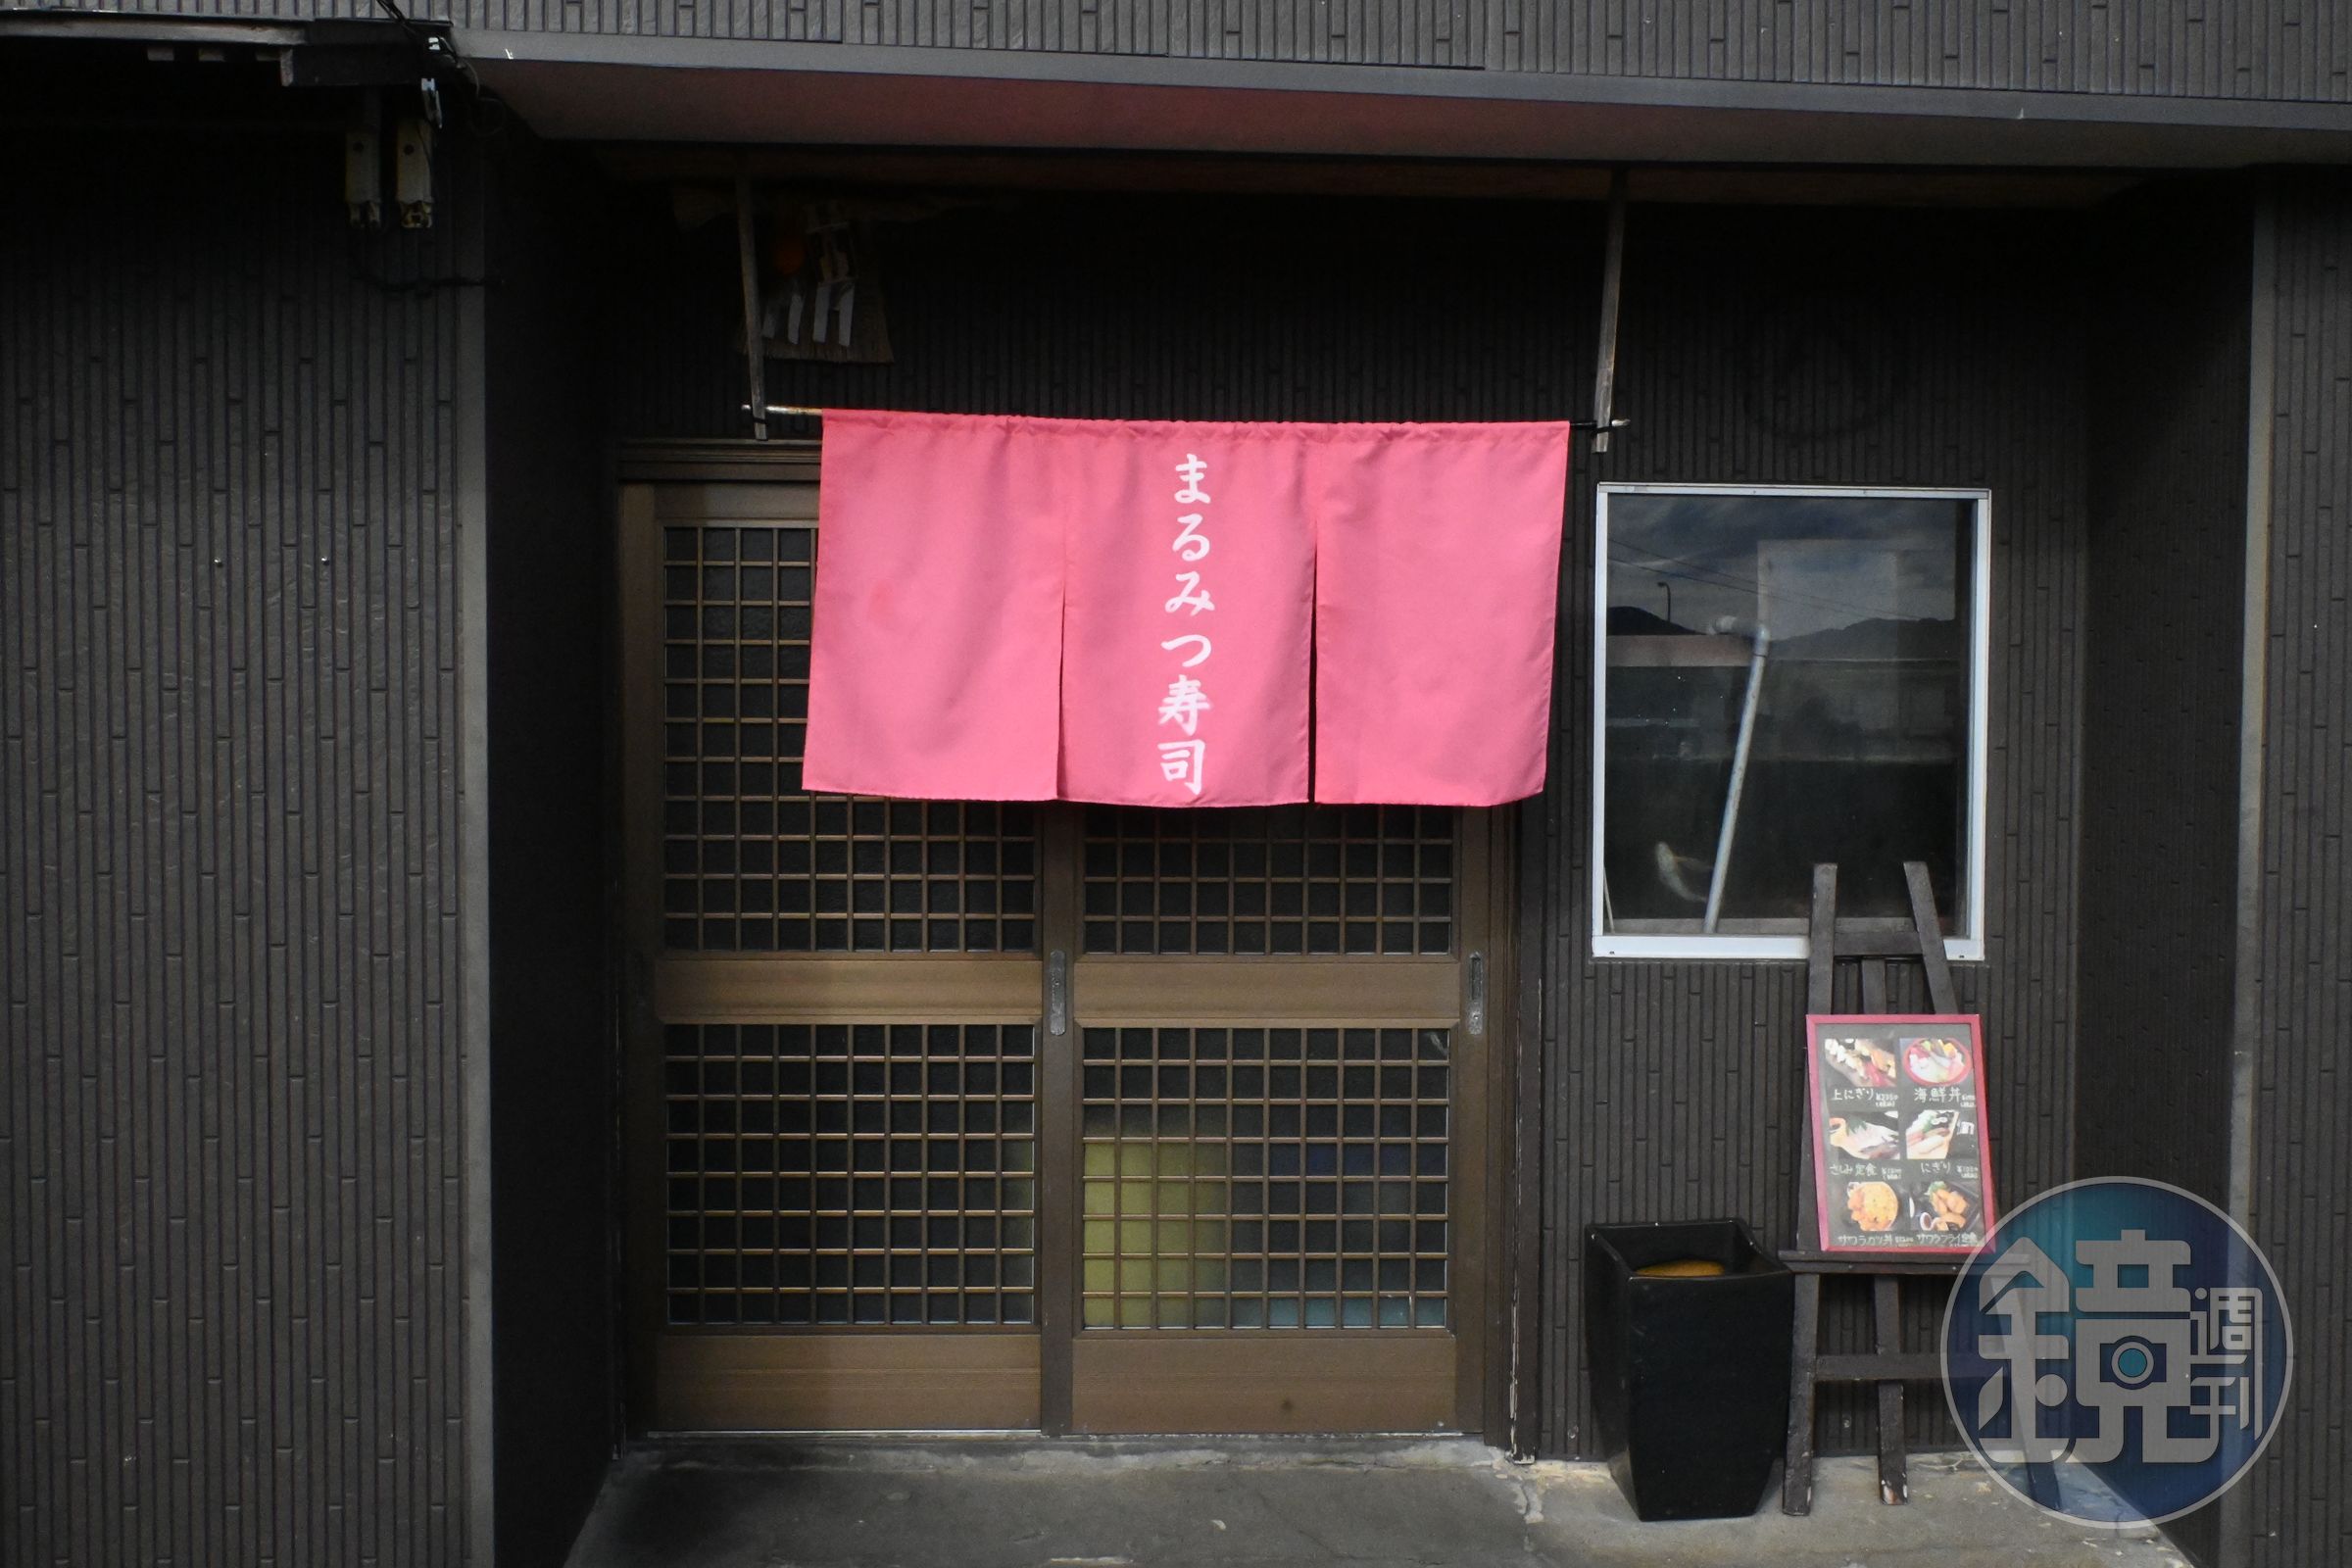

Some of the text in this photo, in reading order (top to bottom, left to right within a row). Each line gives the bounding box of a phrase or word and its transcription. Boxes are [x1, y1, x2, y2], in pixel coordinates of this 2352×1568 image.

[1157, 453, 1215, 796] まるみつ寿司
[1832, 1088, 1874, 1101] 上にぎり
[1914, 1087, 1961, 1102] 海鮮丼
[1921, 1161, 1950, 1174] にぎり
